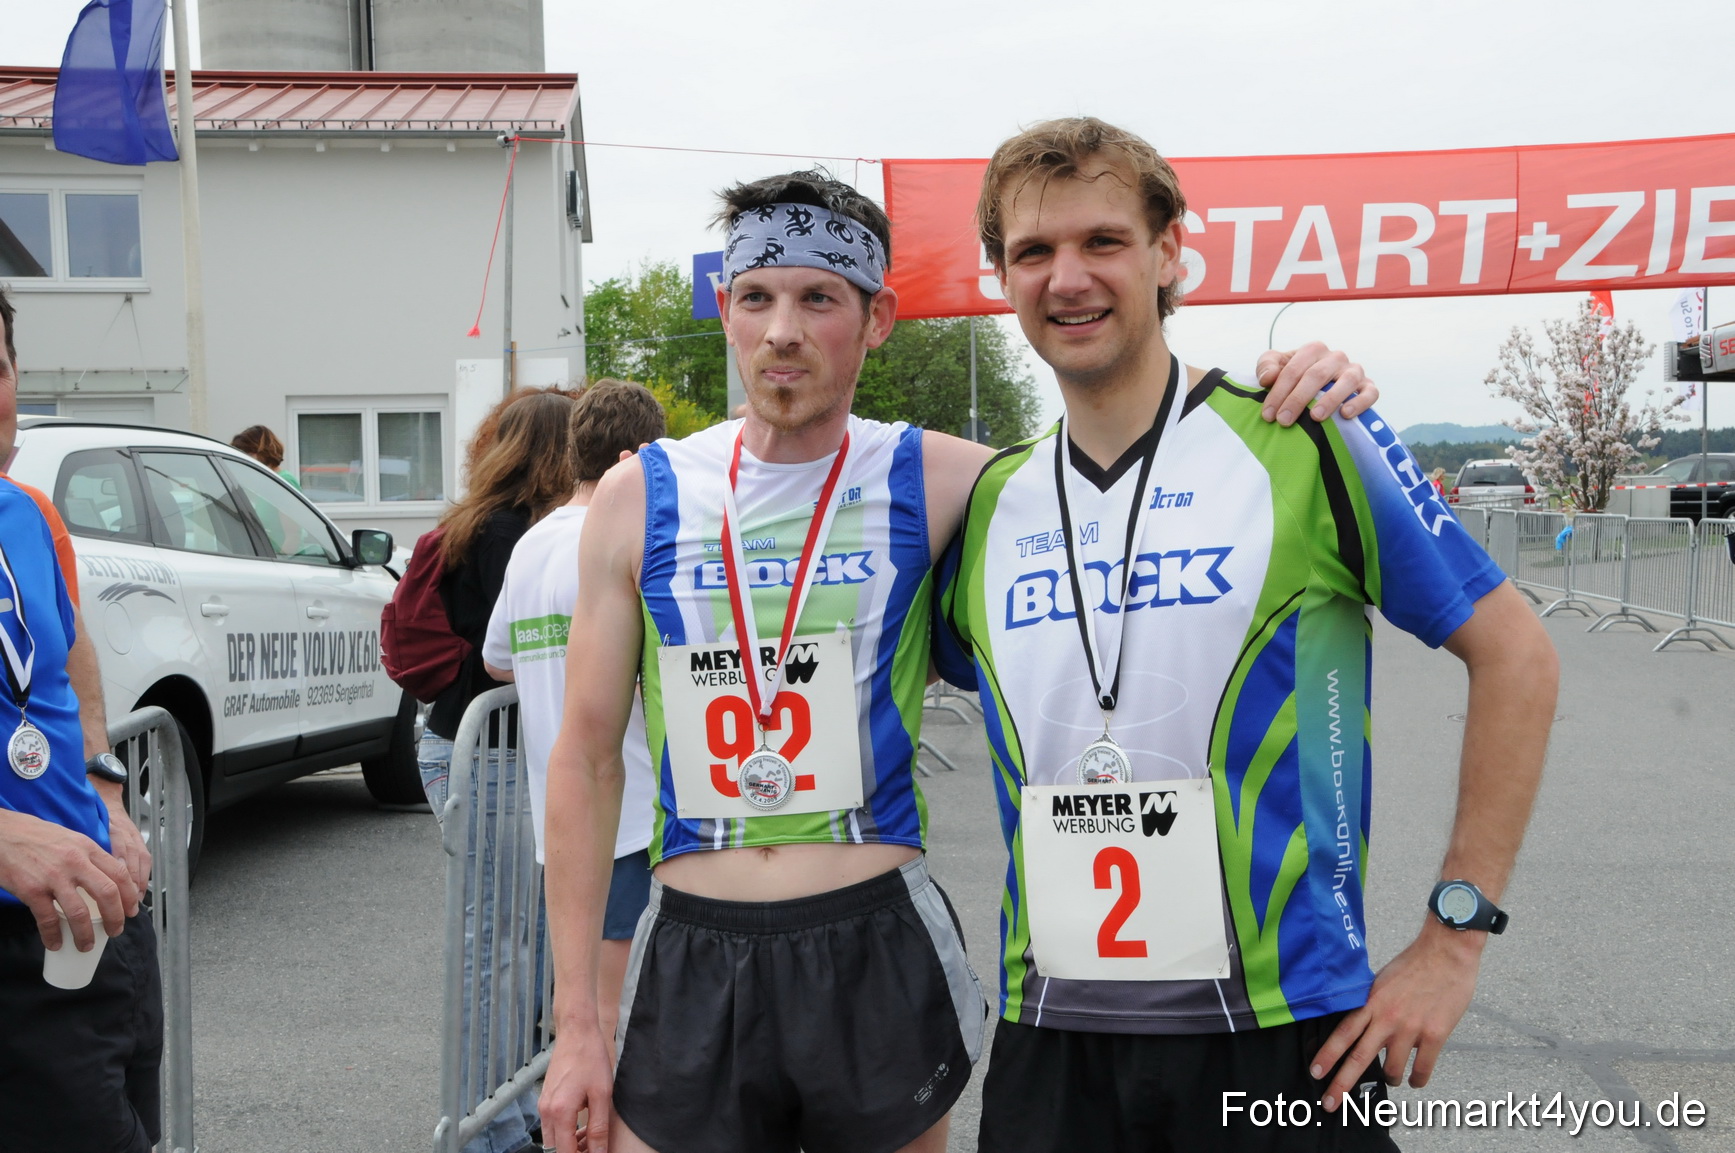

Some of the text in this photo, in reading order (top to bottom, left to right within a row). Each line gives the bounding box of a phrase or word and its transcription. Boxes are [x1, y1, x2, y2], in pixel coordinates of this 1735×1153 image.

[1347, 395, 1457, 537] OCK
[1015, 521, 1099, 558] TEAM
[694, 551, 876, 589] BOCK
[1005, 546, 1235, 630] BOCK
[226, 633, 255, 682] DER
[260, 632, 298, 680] NEUE
[303, 631, 345, 677] VOLVO
[690, 645, 777, 672] MEYR
[691, 667, 778, 687] WERBUG
[224, 679, 375, 718] GRAF Automobile 92369 Sengenthal
[705, 691, 816, 798] 92
[1052, 793, 1133, 816] MEYER
[1327, 668, 1361, 950] www.bockonline.de
[1053, 817, 1135, 833] WERBUNG
[1093, 846, 1148, 957] 2
